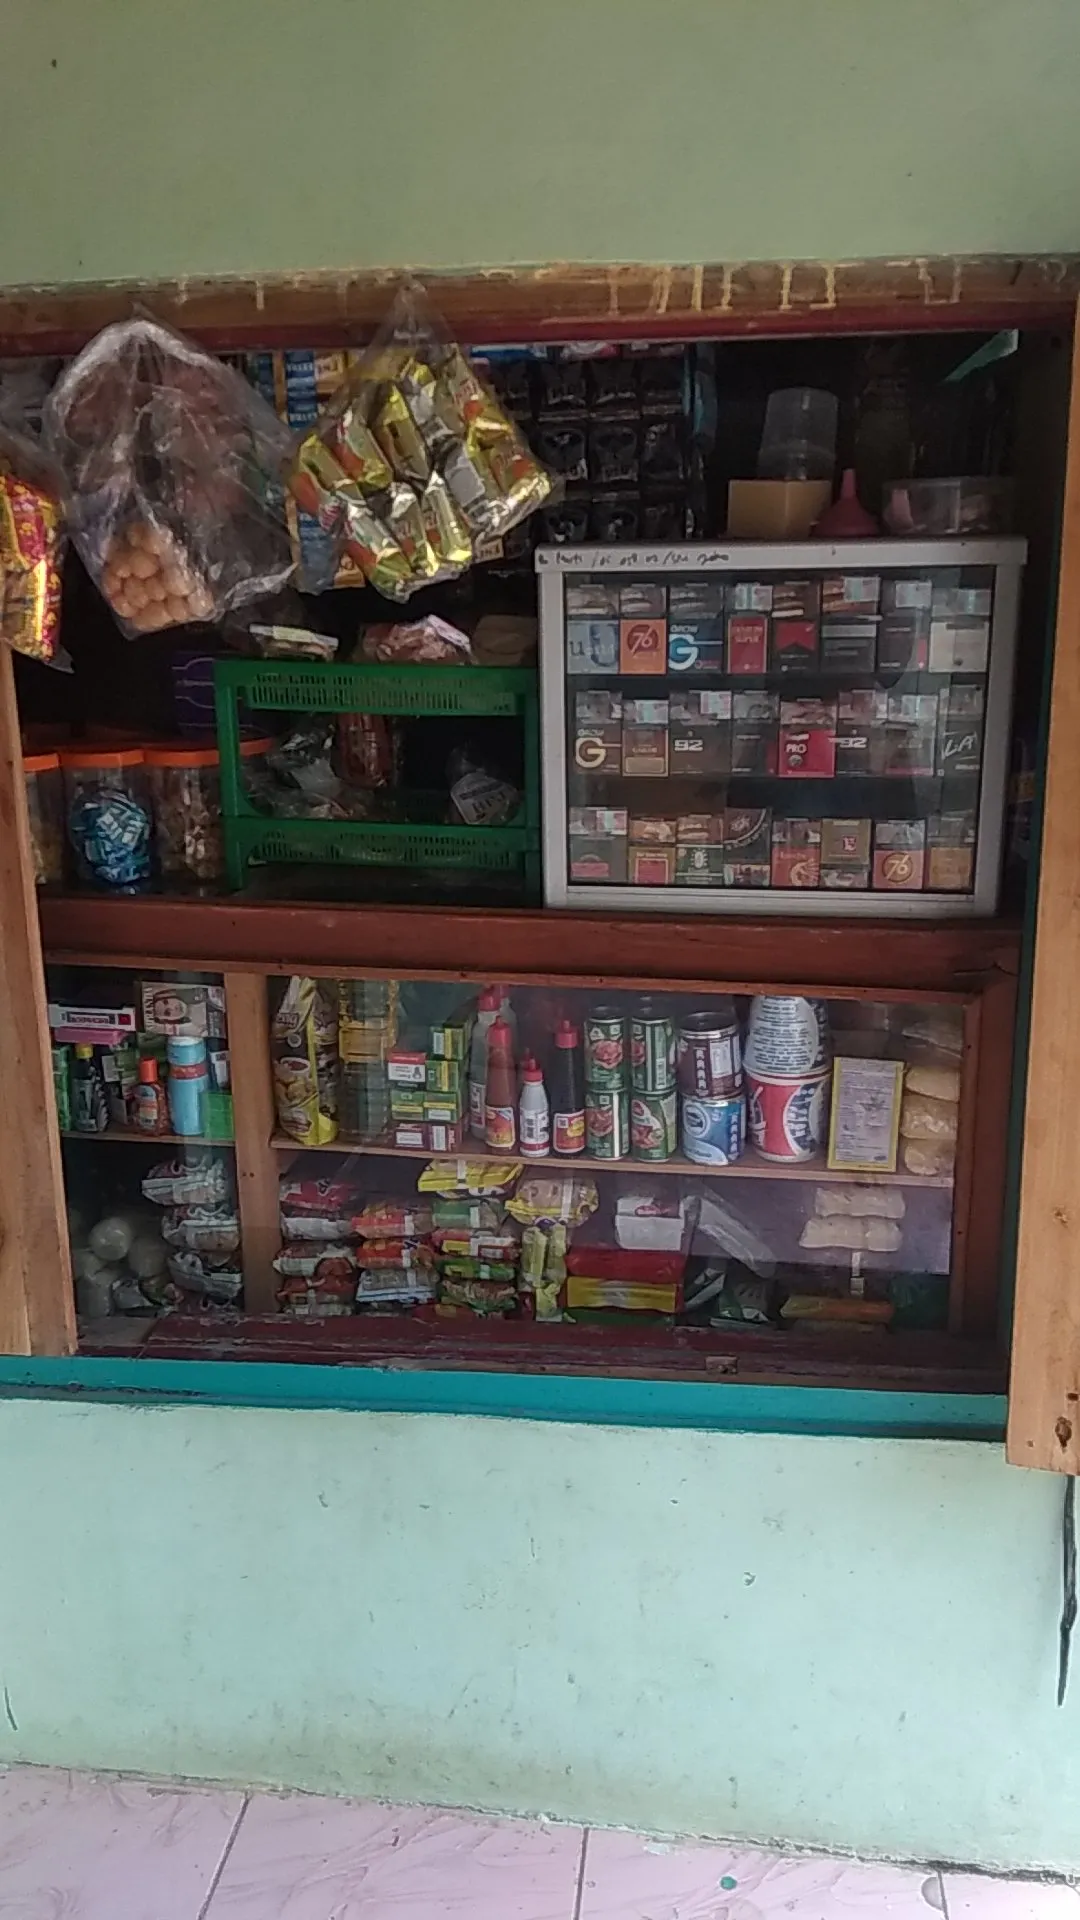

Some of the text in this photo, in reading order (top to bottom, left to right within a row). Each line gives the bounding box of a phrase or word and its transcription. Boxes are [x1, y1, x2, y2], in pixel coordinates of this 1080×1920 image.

[631, 626, 653, 653] 76
[674, 739, 703, 751] 92
[887, 854, 909, 879] 76
